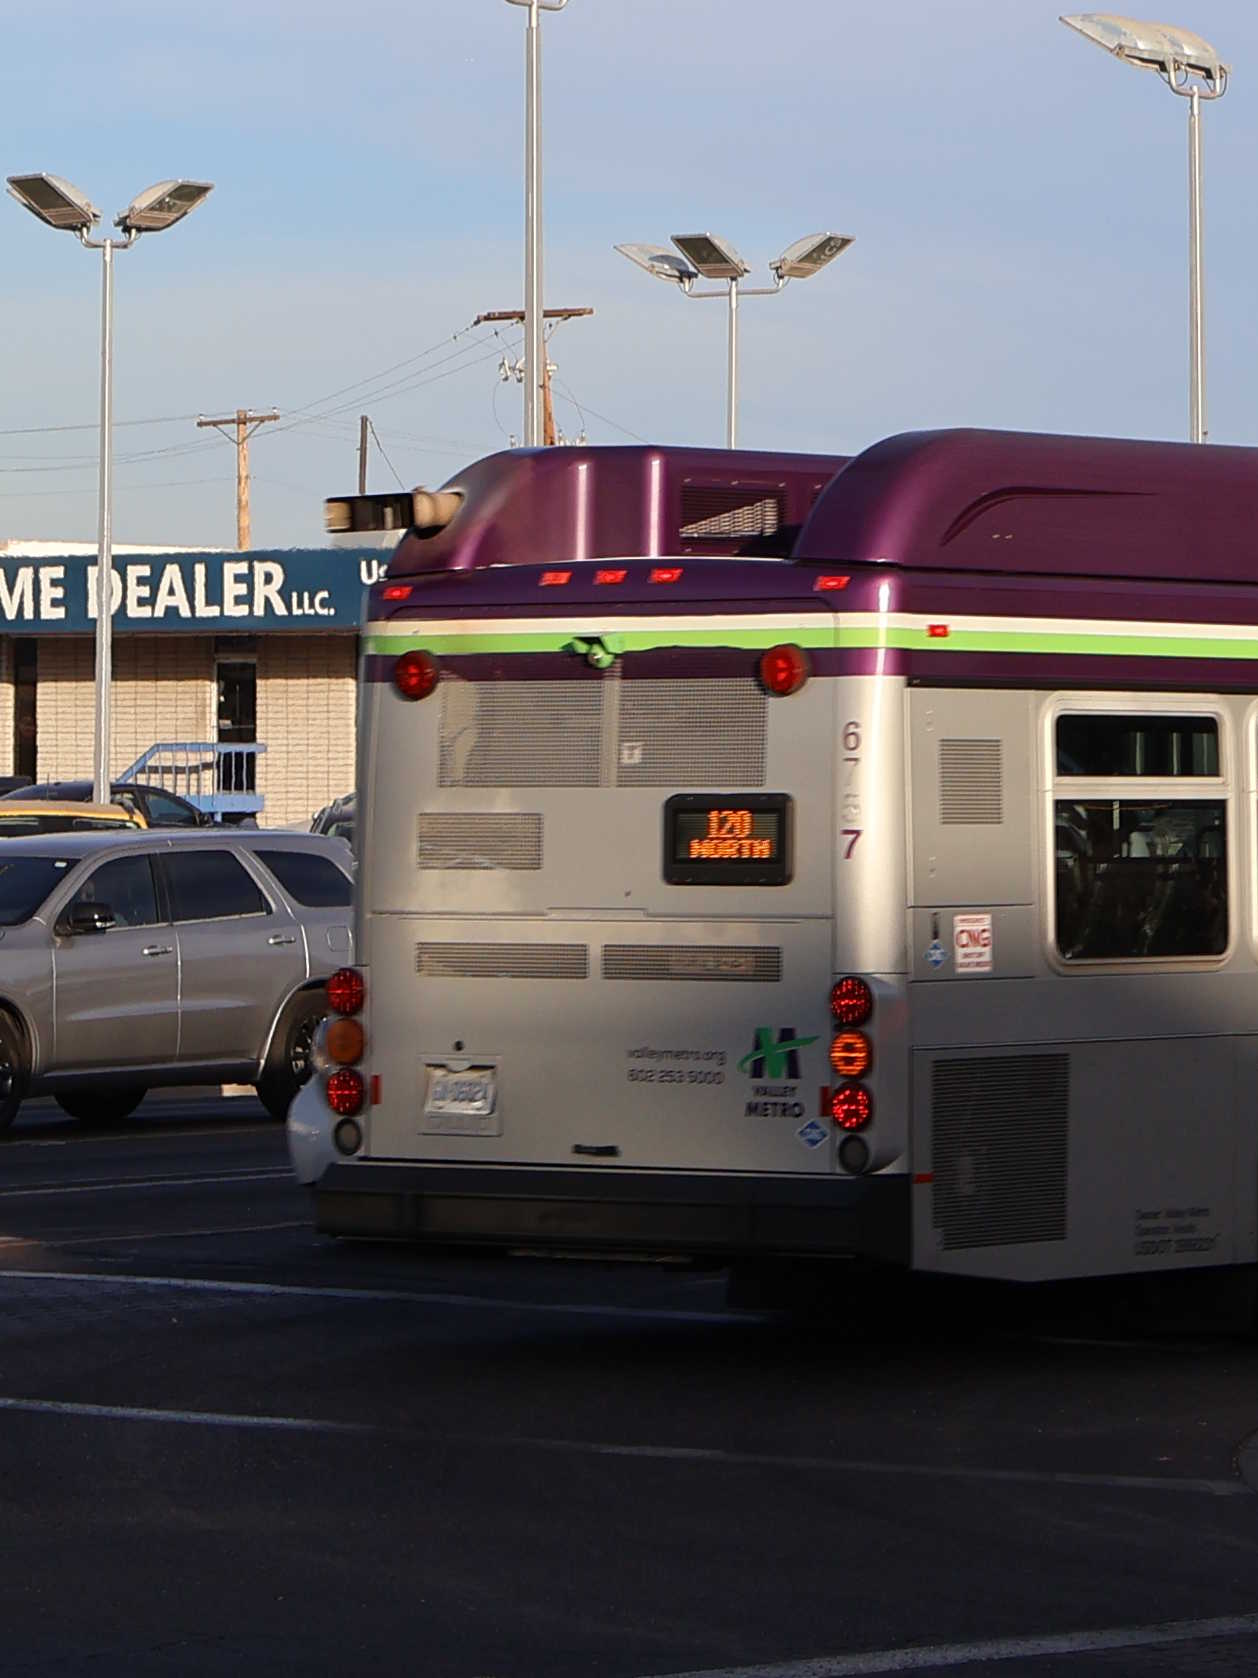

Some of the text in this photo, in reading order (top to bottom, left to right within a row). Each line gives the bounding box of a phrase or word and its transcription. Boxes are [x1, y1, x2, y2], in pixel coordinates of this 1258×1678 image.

[86, 560, 288, 619] DEALER
[291, 590, 336, 616] LLC.
[707, 810, 754, 838] 120
[689, 839, 772, 859] NORTH
[955, 928, 993, 949] CNG
[627, 1046, 726, 1066] valleymetro.org
[627, 1067, 655, 1083] 602
[754, 1086, 798, 1097] VALLEY
[745, 1101, 805, 1118] METRO
